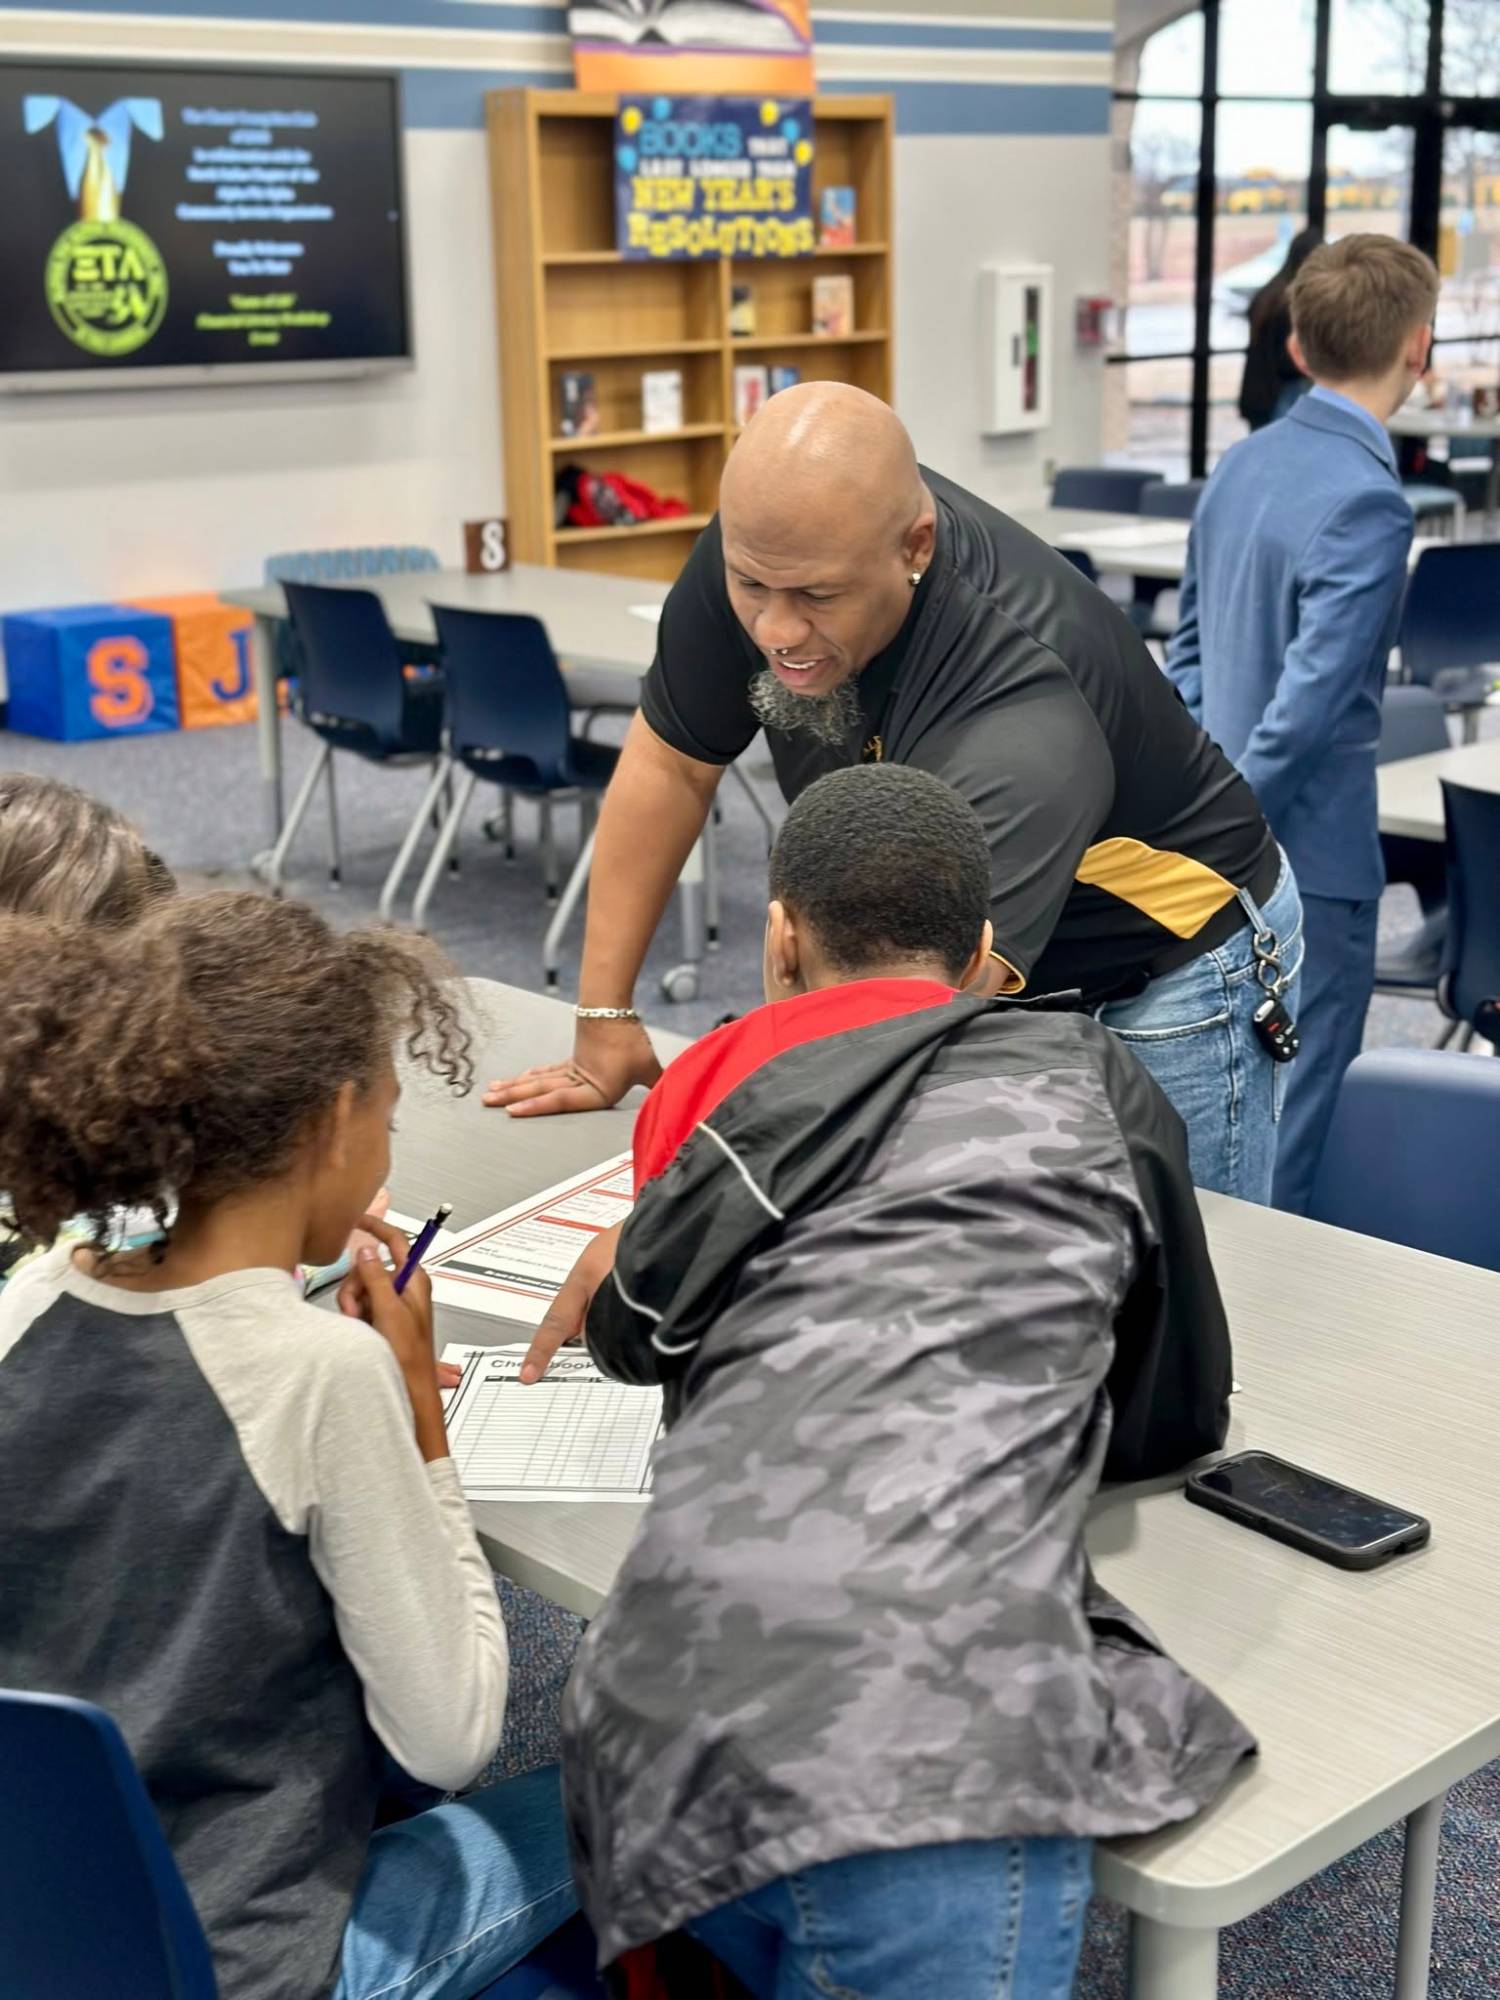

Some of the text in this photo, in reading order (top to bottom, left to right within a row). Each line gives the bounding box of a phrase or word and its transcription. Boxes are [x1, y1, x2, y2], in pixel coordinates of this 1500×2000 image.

[640, 121, 741, 156] BOOKS
[631, 177, 695, 210] NEW
[86, 634, 154, 728] S
[211, 629, 251, 701] J
